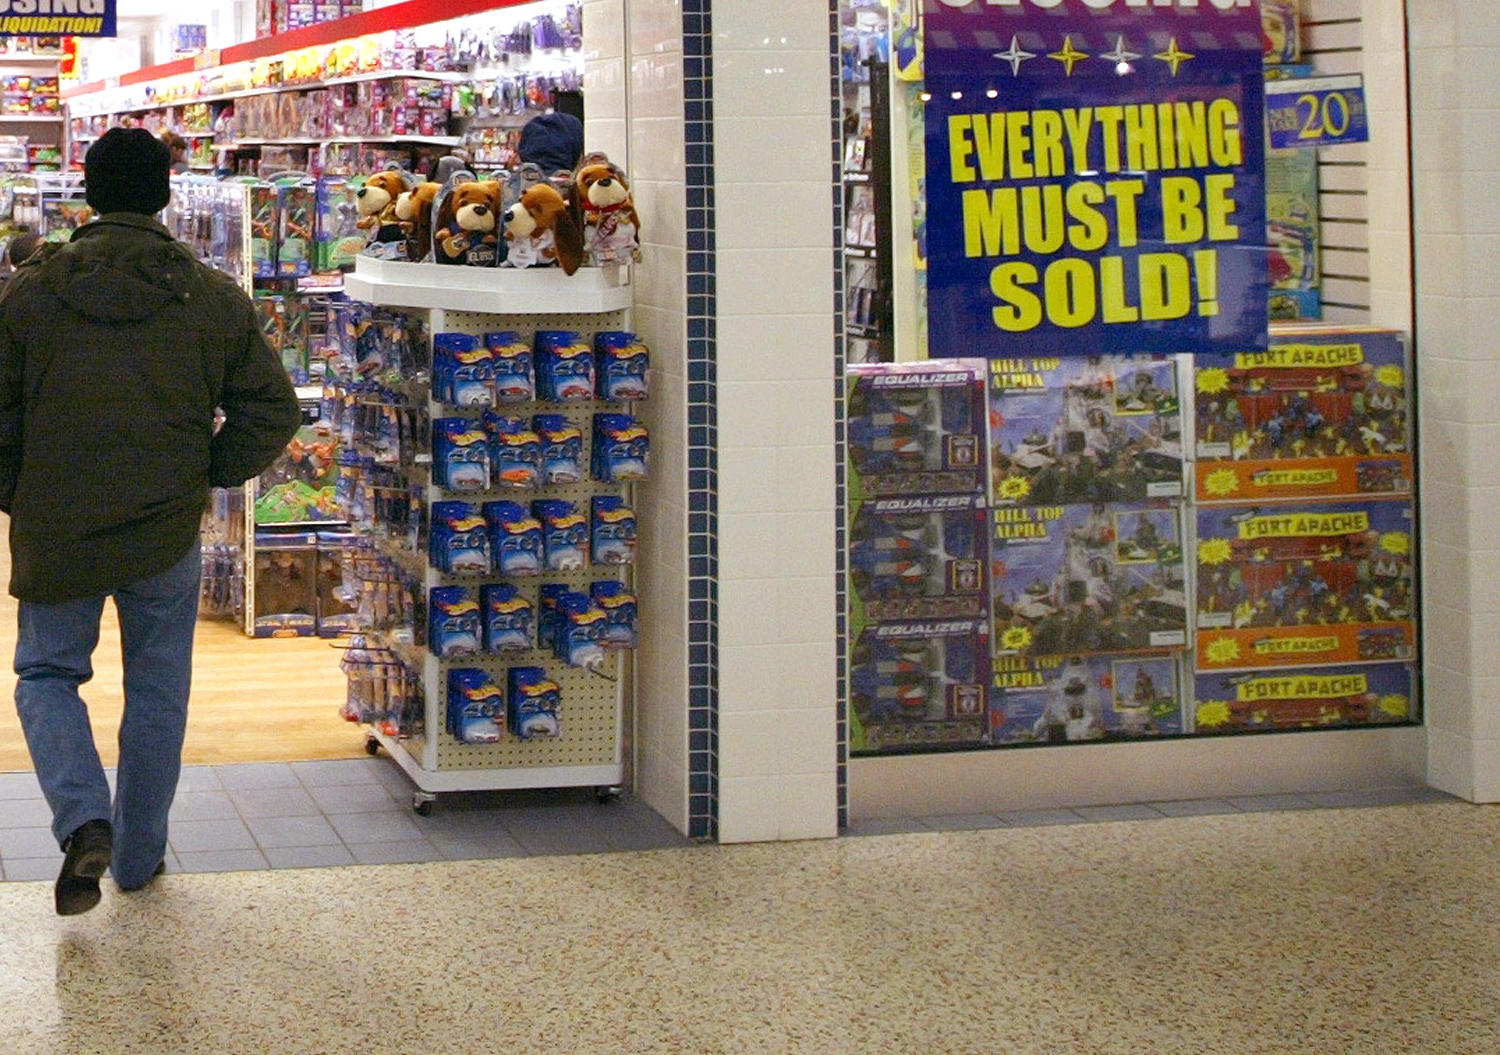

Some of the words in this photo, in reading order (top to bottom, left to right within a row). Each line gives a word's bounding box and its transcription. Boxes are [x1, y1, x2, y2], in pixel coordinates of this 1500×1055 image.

[1296, 92, 1349, 138] 20
[948, 99, 1243, 183] EVERYTHING
[962, 179, 1144, 258] MUST
[1161, 174, 1238, 242] BE
[989, 249, 1218, 333] SOLD!
[1242, 350, 1287, 365] FORT
[1292, 347, 1358, 364] APACHE
[873, 373, 969, 385] EQUALIZER
[992, 374, 1044, 388] ALPHA
[876, 497, 971, 509] EQUALIZER
[995, 523, 1046, 538] ALPHA
[1245, 519, 1292, 534] FORT
[1299, 516, 1363, 532] APACHE
[878, 622, 973, 635] EQUALIZER
[1243, 682, 1292, 697] FORT
[1296, 678, 1361, 695] APACHE
